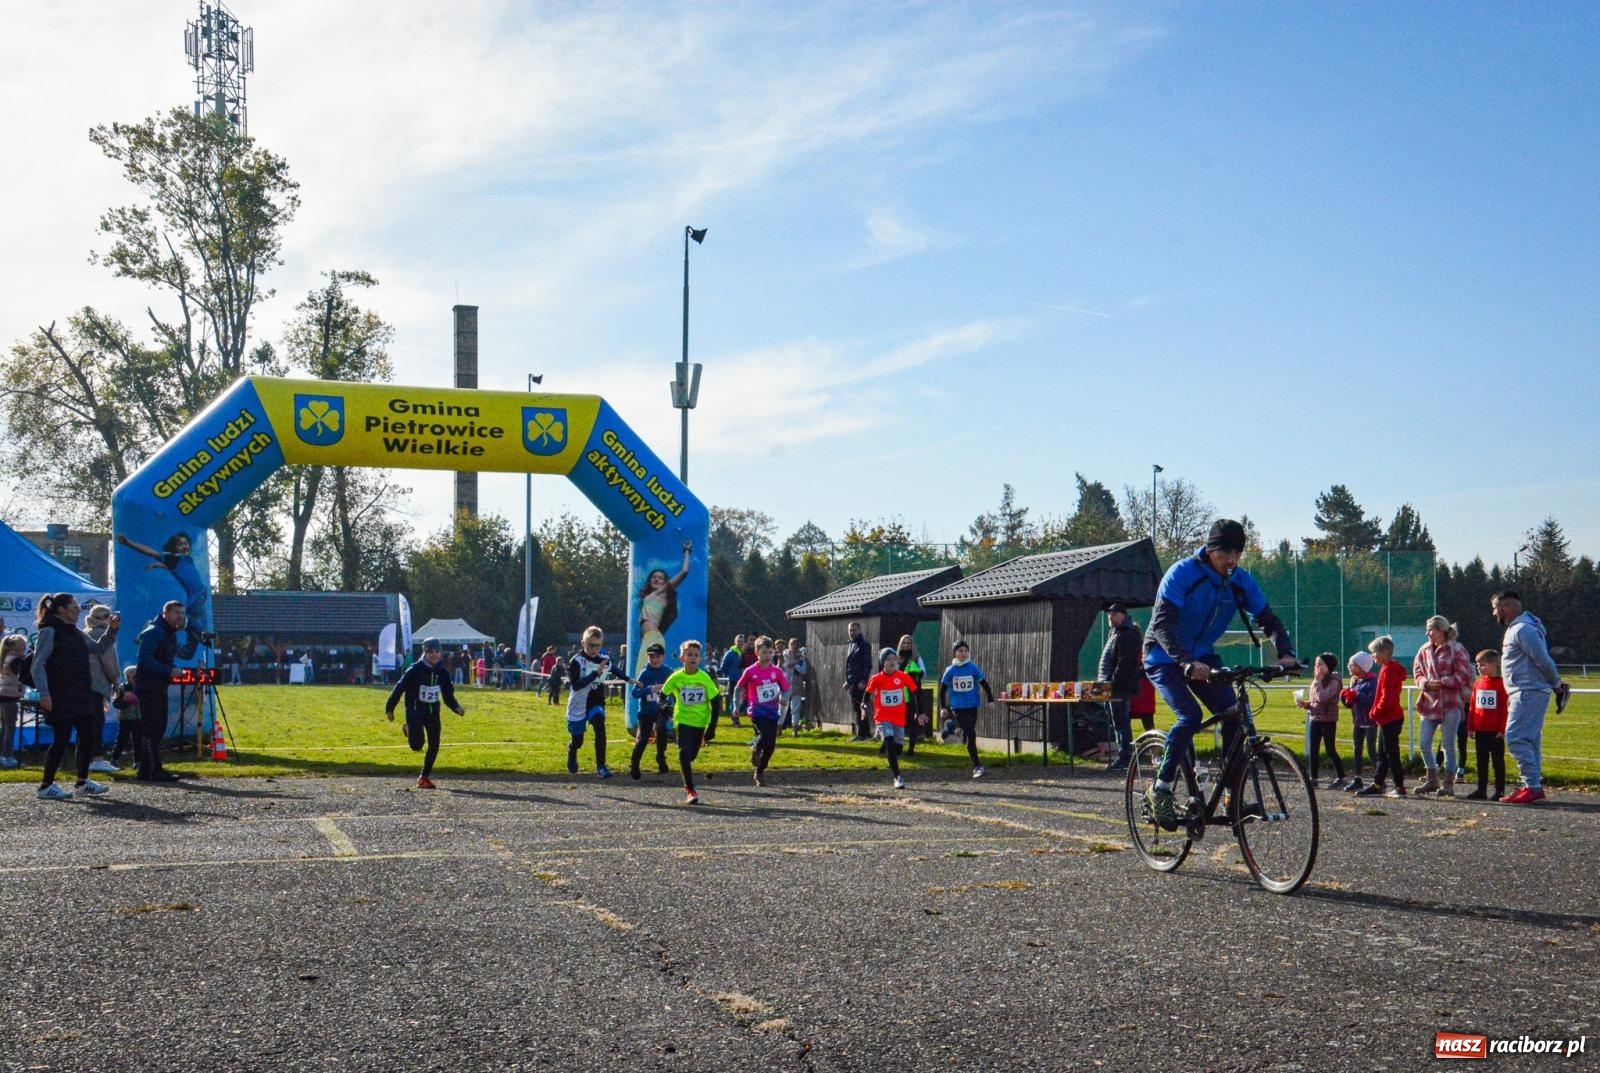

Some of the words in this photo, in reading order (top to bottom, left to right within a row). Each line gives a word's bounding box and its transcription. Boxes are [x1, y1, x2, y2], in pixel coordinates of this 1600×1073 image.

[388, 399, 480, 417] Gmina
[365, 416, 505, 438] Pietrowice
[153, 449, 212, 499] Gmina
[207, 409, 256, 453] ludzi
[383, 438, 485, 457] Wielkie
[177, 432, 272, 515] aktywnych
[602, 429, 647, 480] Gmina
[645, 475, 685, 517] ludzi
[586, 449, 666, 531] aktywnych
[762, 689, 775, 699] 63
[954, 681, 972, 689] 102
[681, 693, 703, 702] 127
[885, 695, 899, 704] 55
